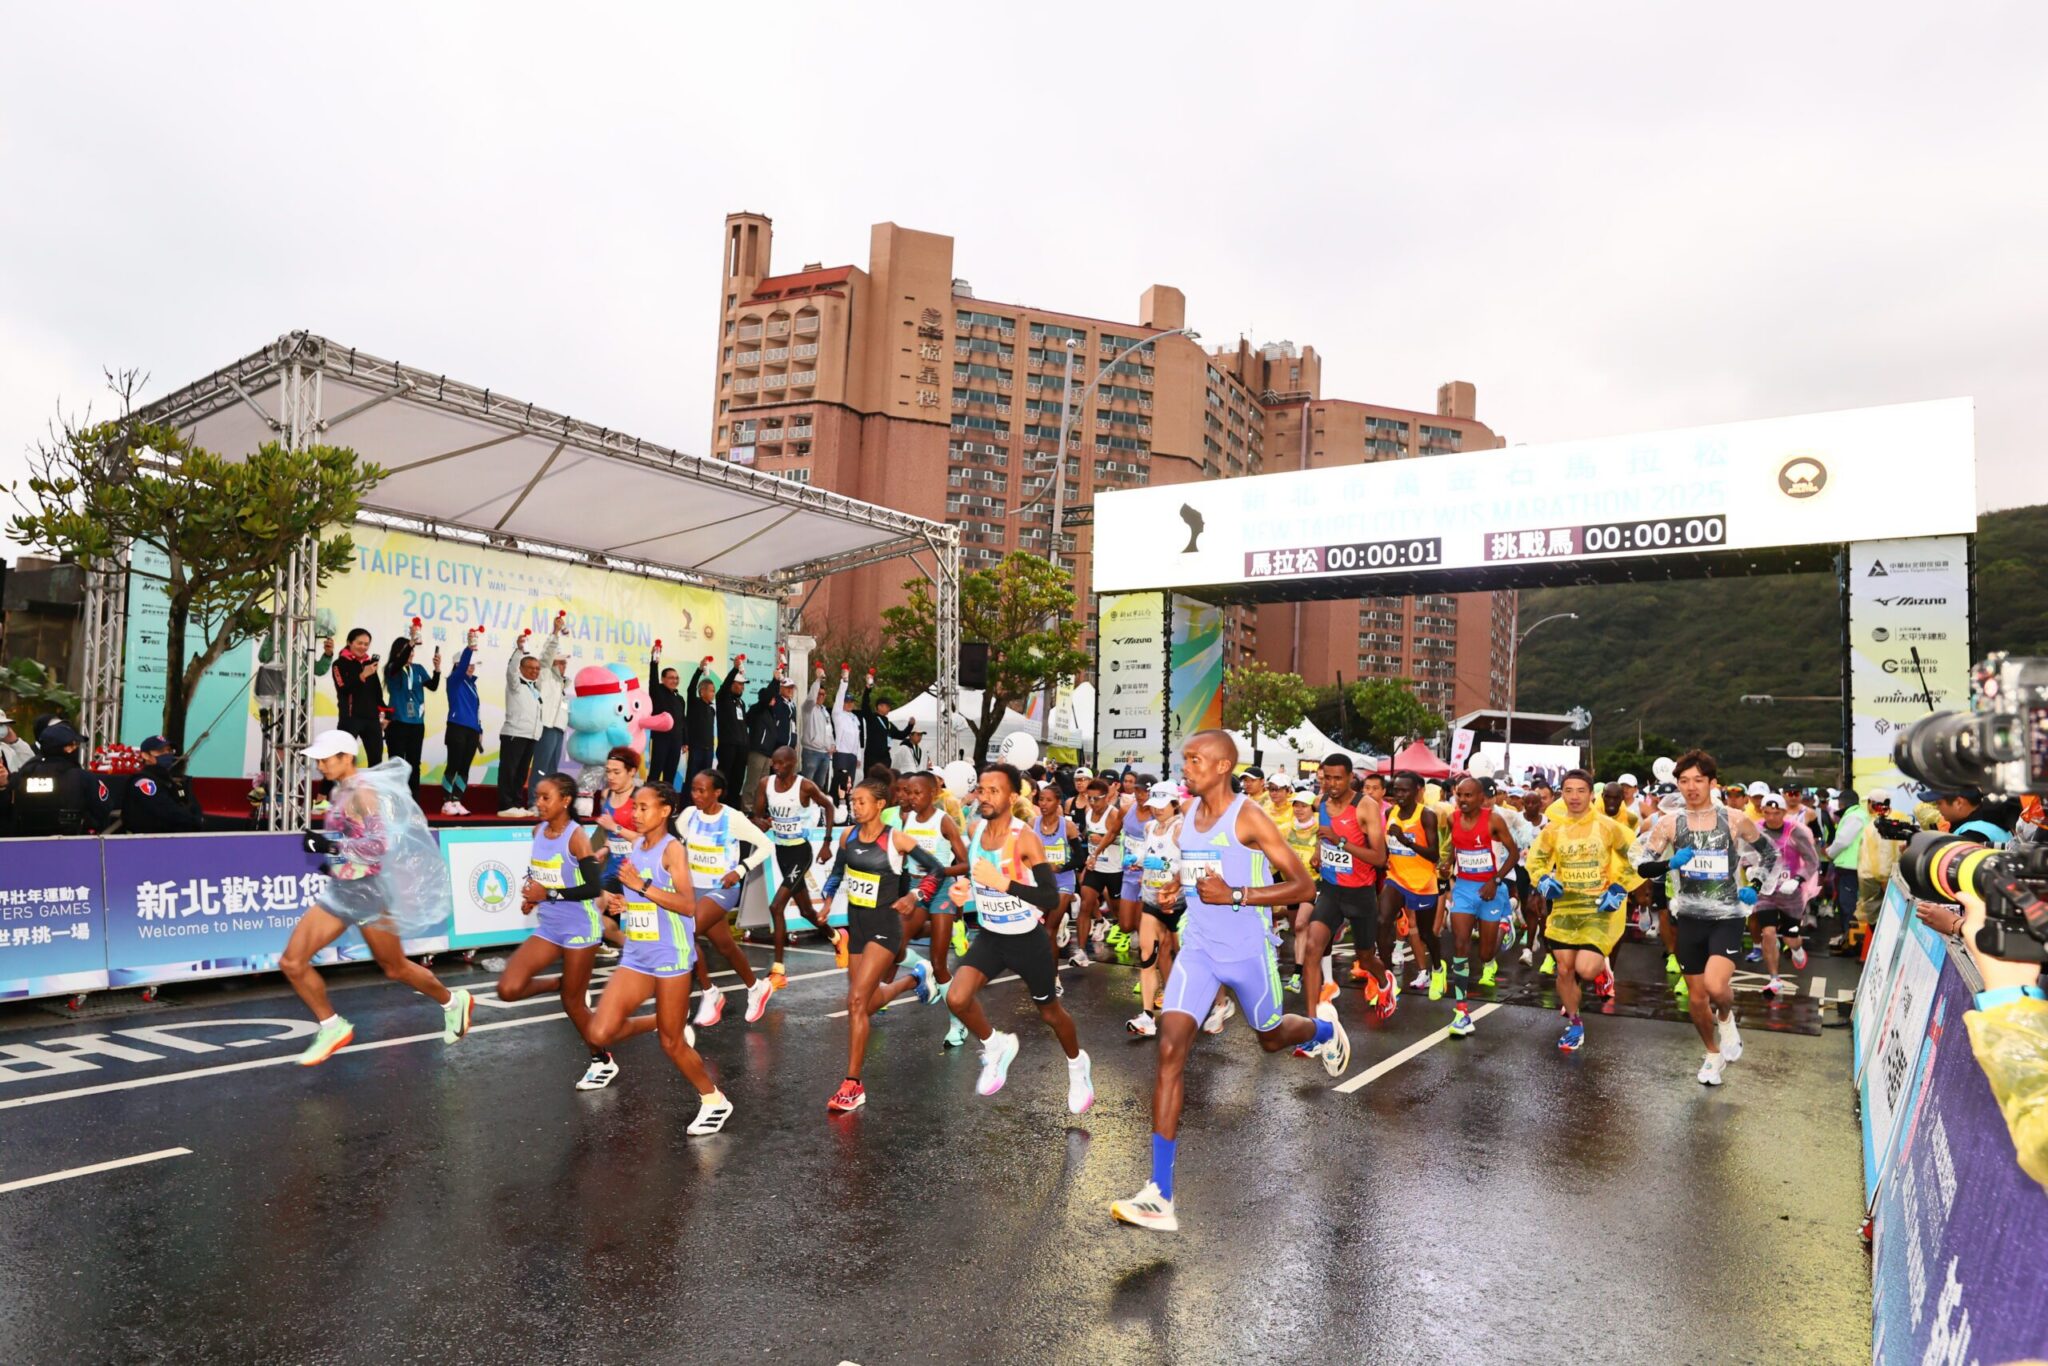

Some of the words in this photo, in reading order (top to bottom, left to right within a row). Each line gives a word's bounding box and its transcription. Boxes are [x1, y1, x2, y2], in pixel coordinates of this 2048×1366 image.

[1651, 480, 1725, 512] 2025
[1491, 529, 1573, 560] 挑戰馬
[1585, 518, 1723, 551] 00:00:00
[356, 545, 431, 581] TAIPEI
[437, 560, 483, 588] CITY
[1251, 548, 1319, 576] 馬拉松
[1327, 540, 1438, 569] 00:00:01
[403, 588, 468, 624] 2025
[531, 606, 652, 648] MRATHON
[1563, 870, 1598, 880] CHANG
[1694, 858, 1713, 869] LIN
[40, 902, 91, 919] GAMES
[982, 896, 1022, 912] HUSEN
[138, 922, 208, 940] Welcome
[213, 918, 228, 933] to
[232, 914, 263, 931] New
[266, 911, 303, 929] Taipe
